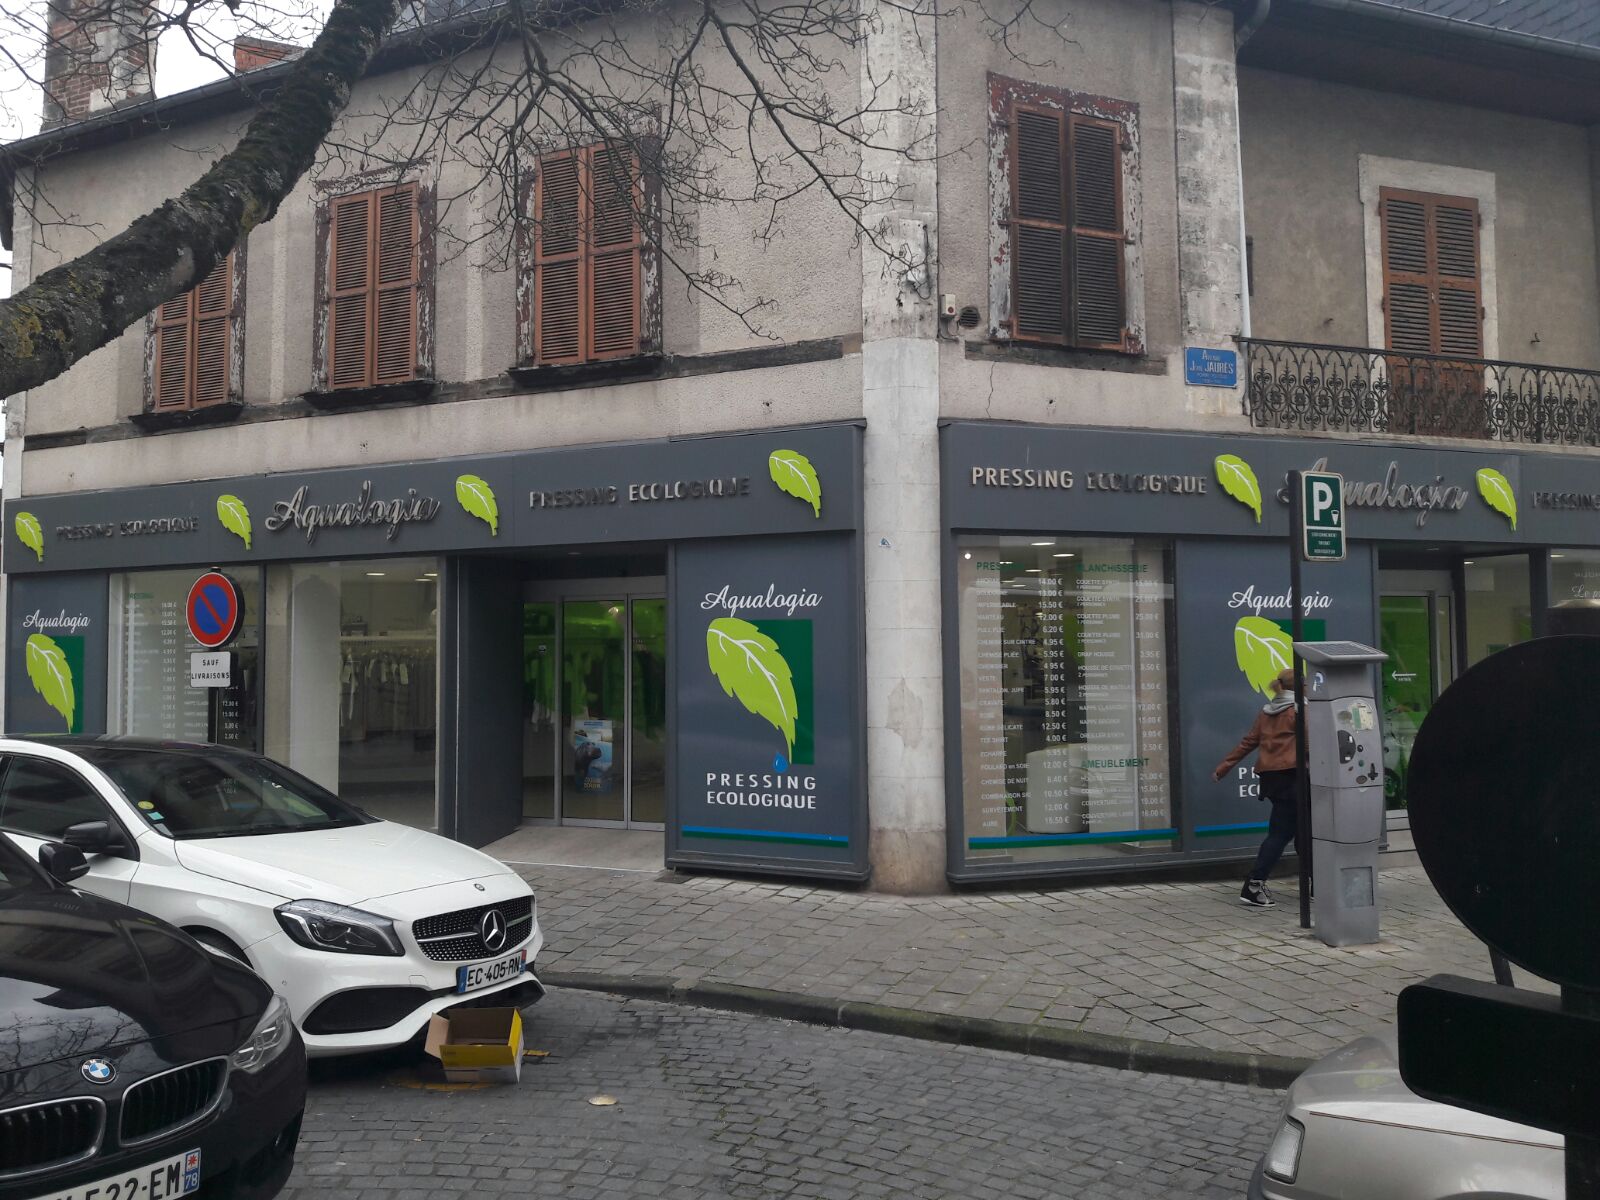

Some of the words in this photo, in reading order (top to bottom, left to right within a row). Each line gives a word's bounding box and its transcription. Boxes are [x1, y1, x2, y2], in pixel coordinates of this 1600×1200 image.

[529, 484, 617, 509] PRESSING
[629, 477, 750, 502] ECOLOGIQUE
[972, 466, 1074, 489] PRESSING
[1086, 471, 1208, 495] ECOLOGIQUE
[1276, 456, 1469, 528] ualogia
[264, 480, 441, 544] Aqualogia
[1313, 481, 1333, 521] P
[700, 583, 822, 618] Aqualogia
[1227, 584, 1333, 617] Aqualgia
[23, 609, 90, 634] Aqualogia
[191, 672, 230, 680] LIVRAISONS
[1081, 758, 1150, 768] AMEUBLEMENT
[706, 771, 817, 791] PRESSING
[706, 791, 817, 810] ECOLOGIQUE
[467, 955, 521, 988] EC-405-RN
[56, 1160, 182, 1200] 22-EM
[185, 1172, 198, 1190] 78
